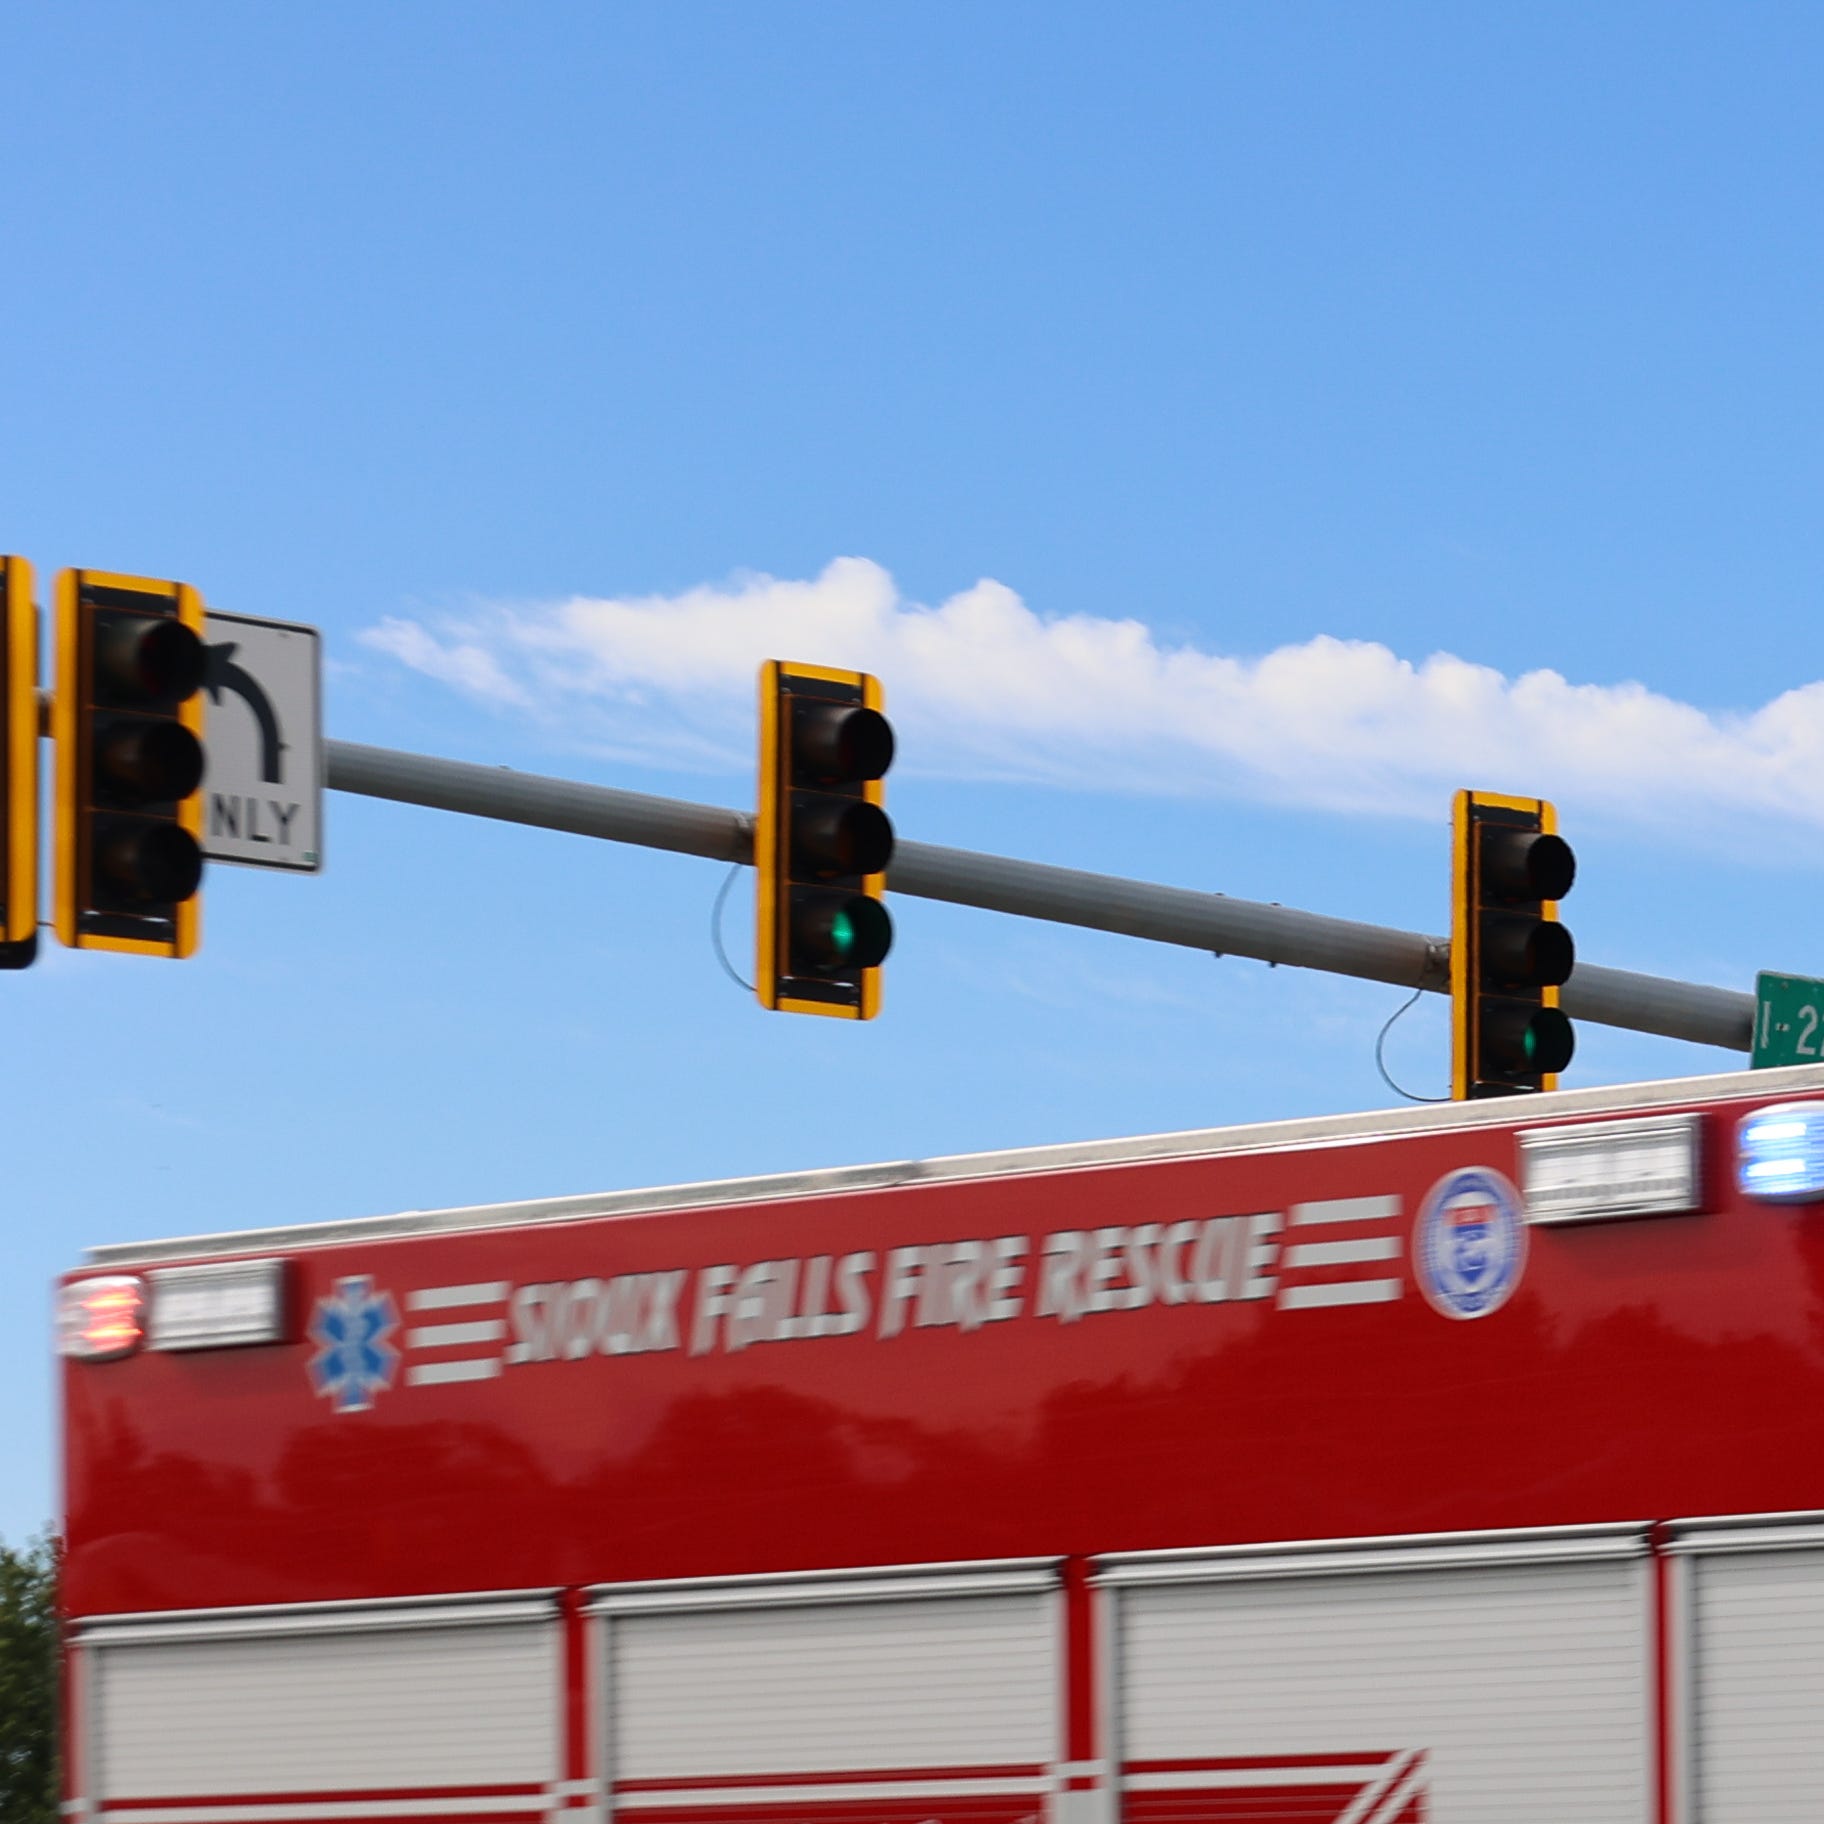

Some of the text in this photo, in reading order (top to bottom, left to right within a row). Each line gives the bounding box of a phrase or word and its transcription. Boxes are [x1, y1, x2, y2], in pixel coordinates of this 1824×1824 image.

[209, 793, 300, 845] NLY
[505, 1212, 1283, 1365] SIOUX FALLS FIRE RESCUE
